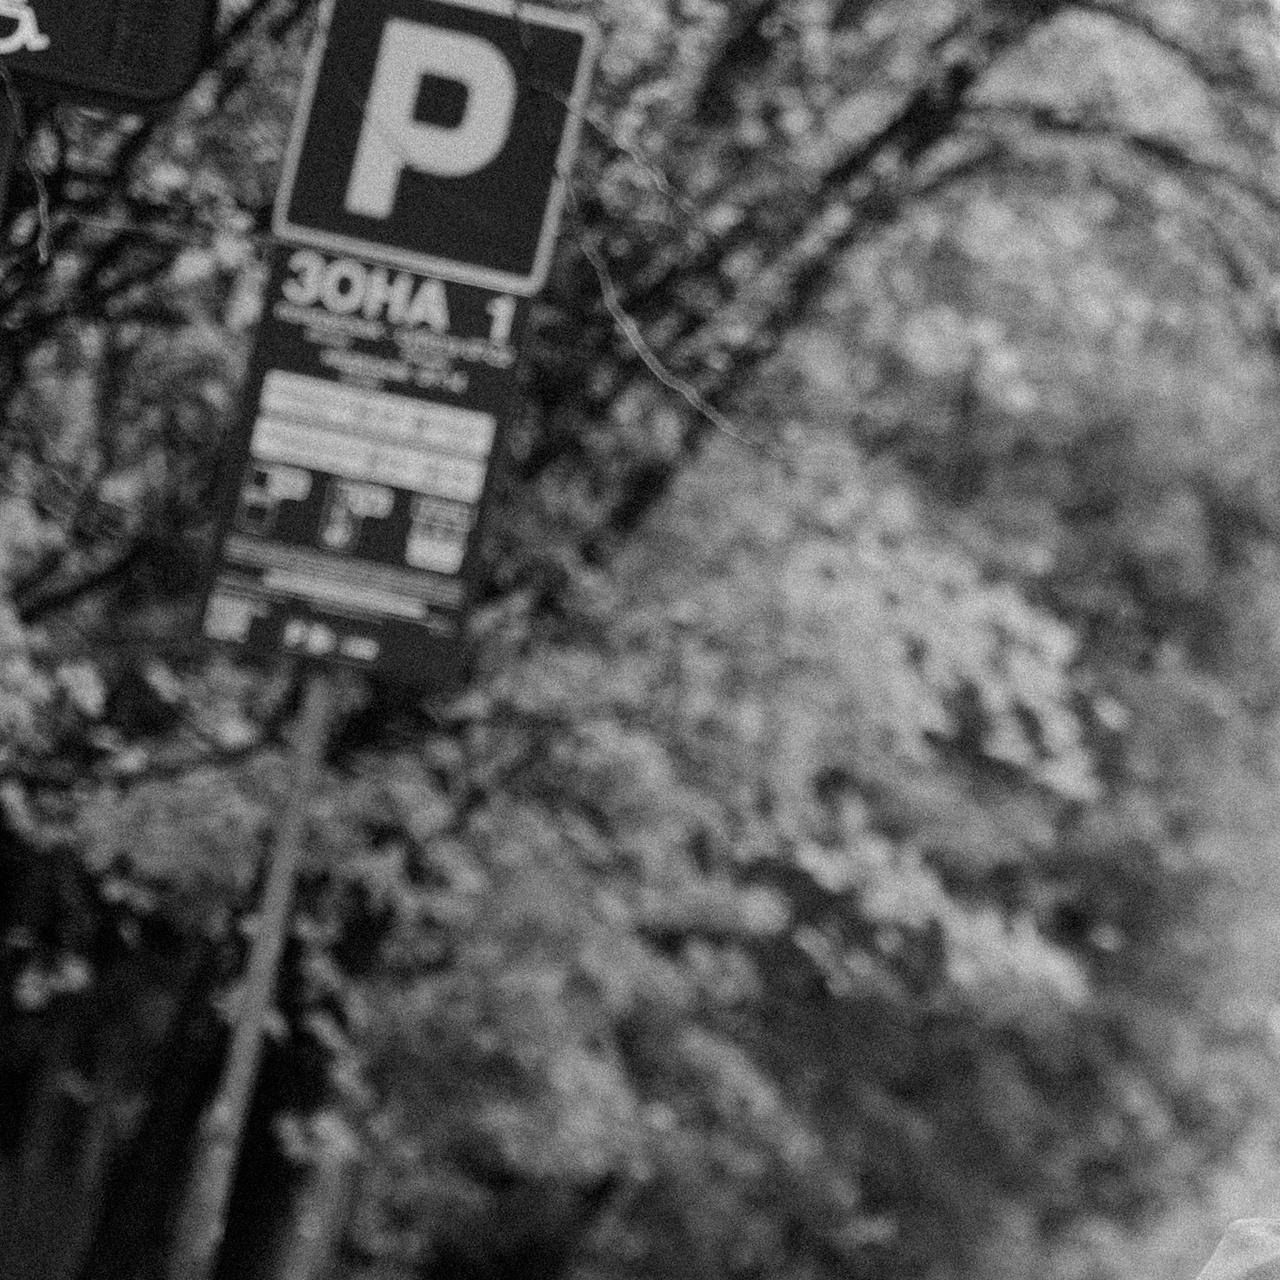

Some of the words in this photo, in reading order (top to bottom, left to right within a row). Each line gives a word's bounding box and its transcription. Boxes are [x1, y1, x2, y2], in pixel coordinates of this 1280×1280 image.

[344, 17, 517, 219] P
[282, 250, 450, 331] ЗОНА
[486, 297, 515, 346] 1
